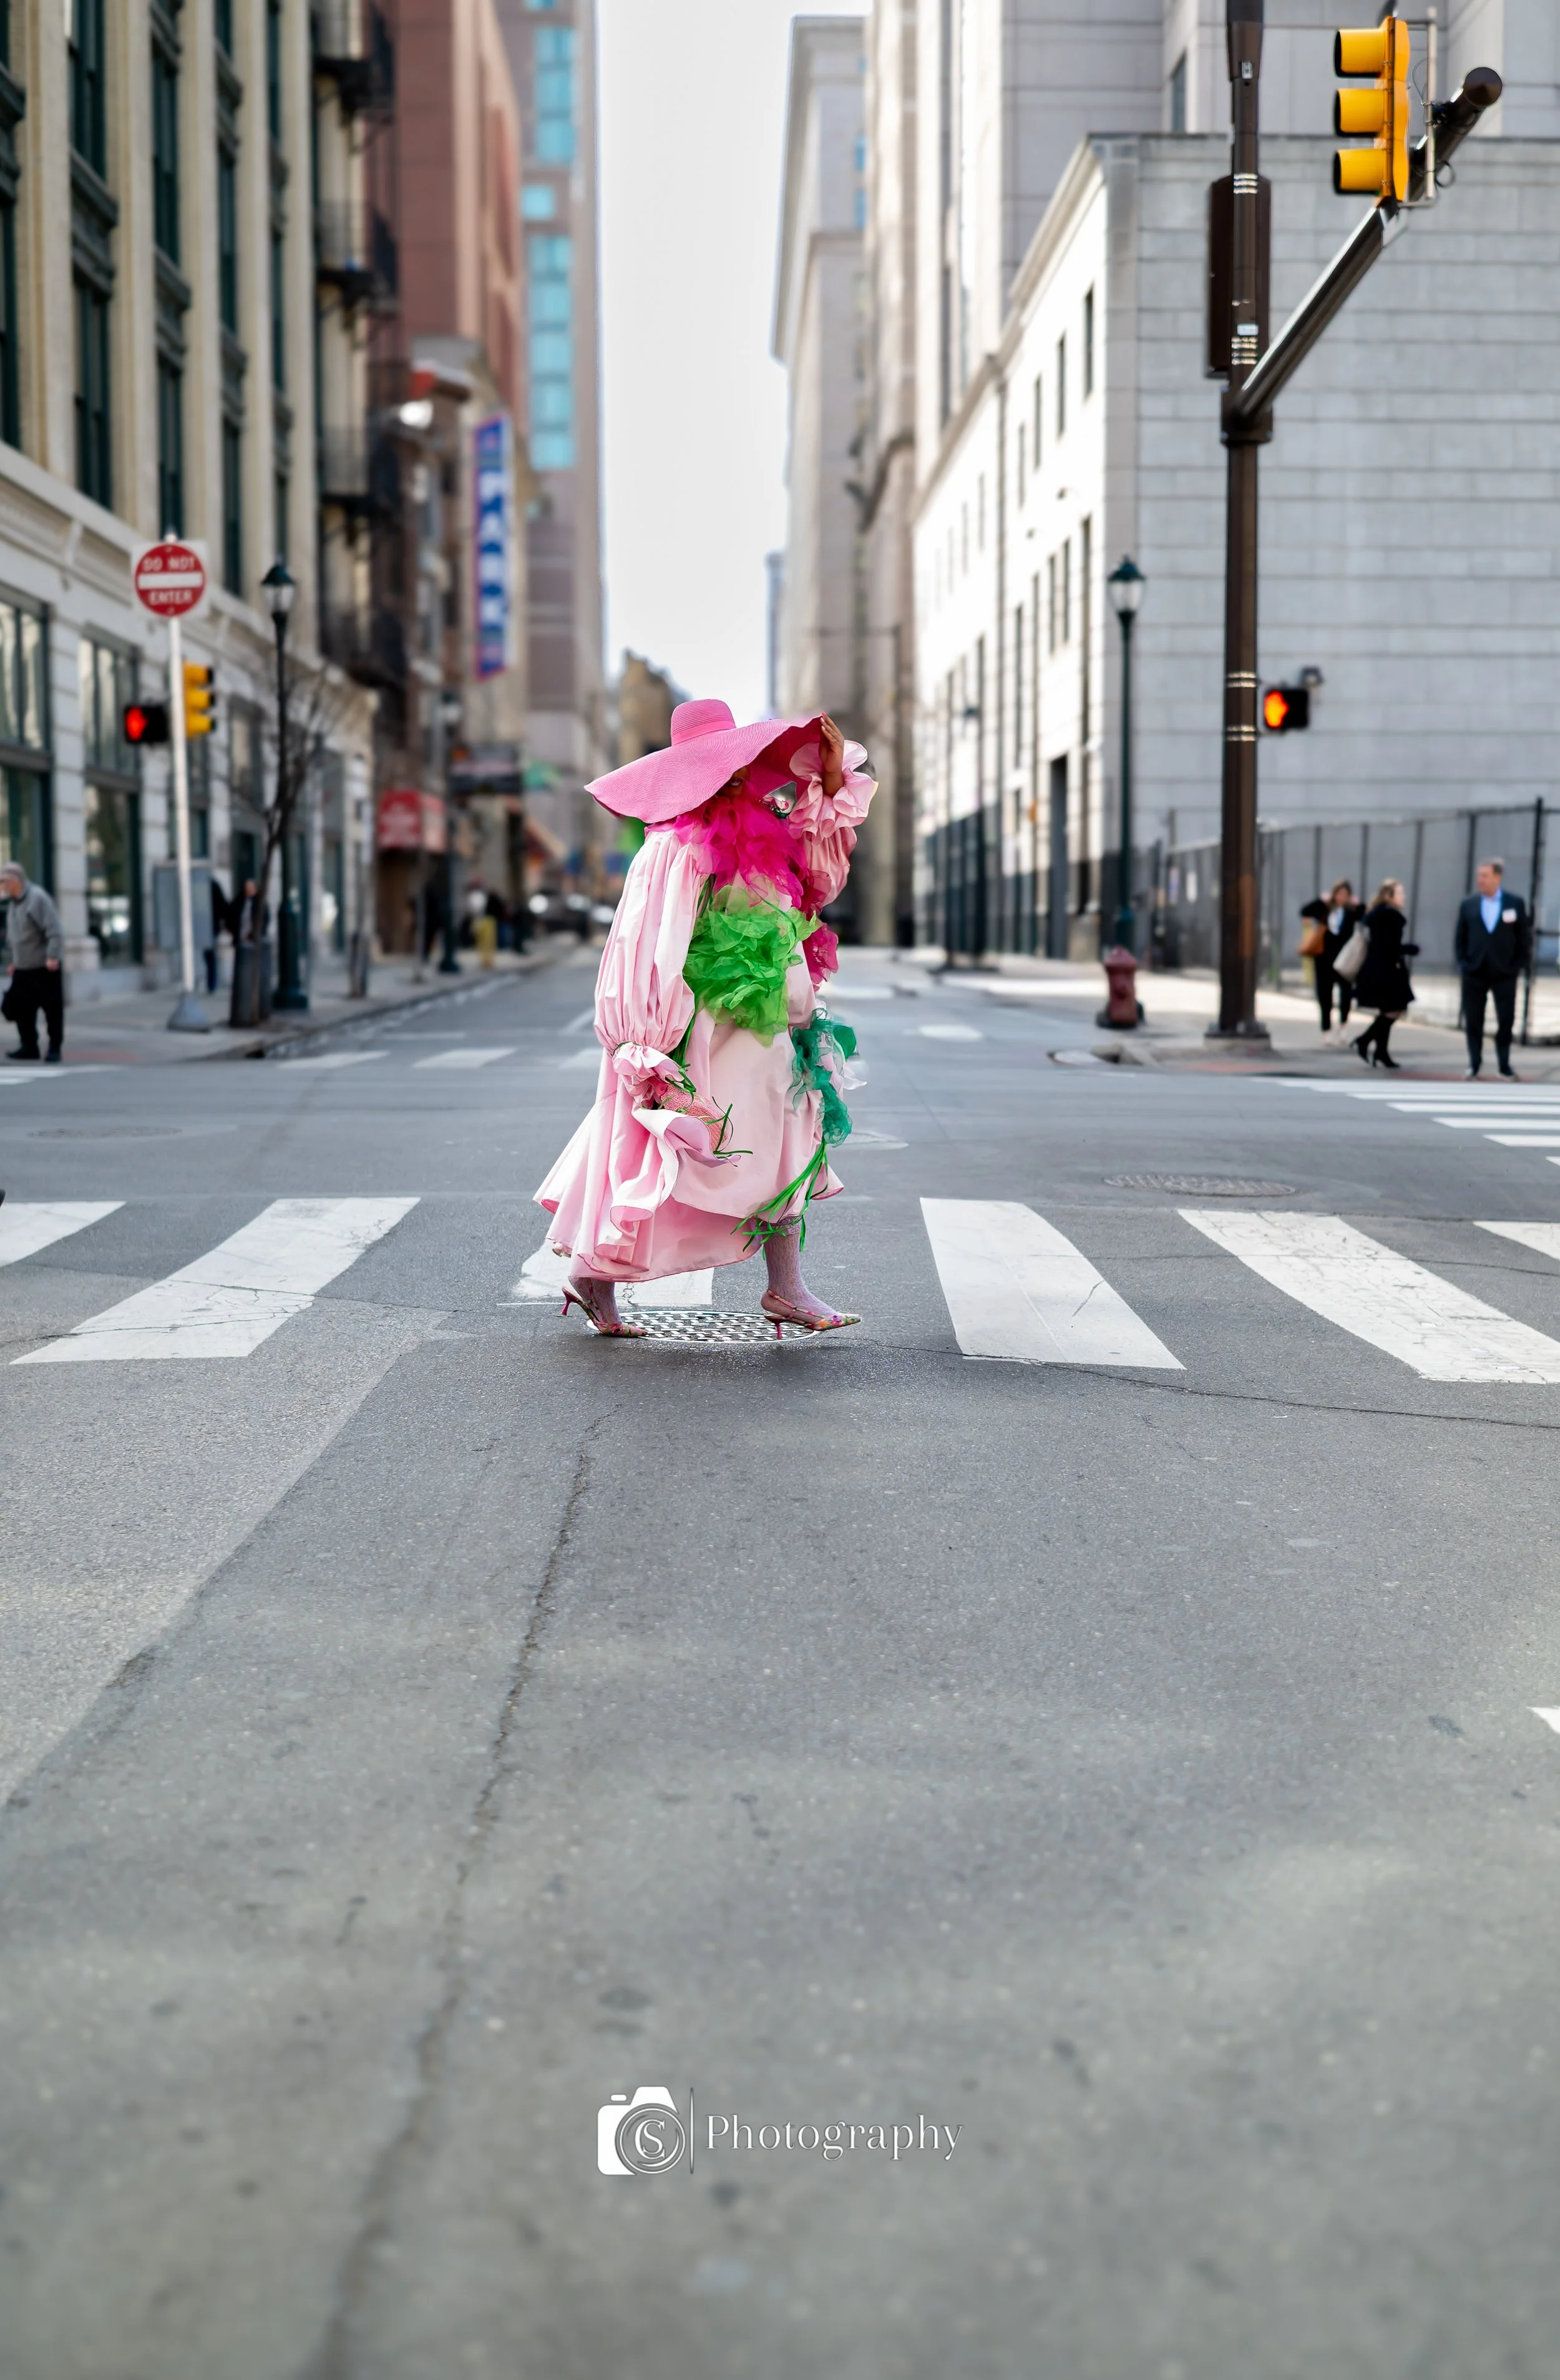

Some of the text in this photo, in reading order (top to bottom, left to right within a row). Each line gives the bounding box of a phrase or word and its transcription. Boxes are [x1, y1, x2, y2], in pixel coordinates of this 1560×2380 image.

[143, 555, 195, 572] DO NOT
[149, 589, 193, 606] ENTER
